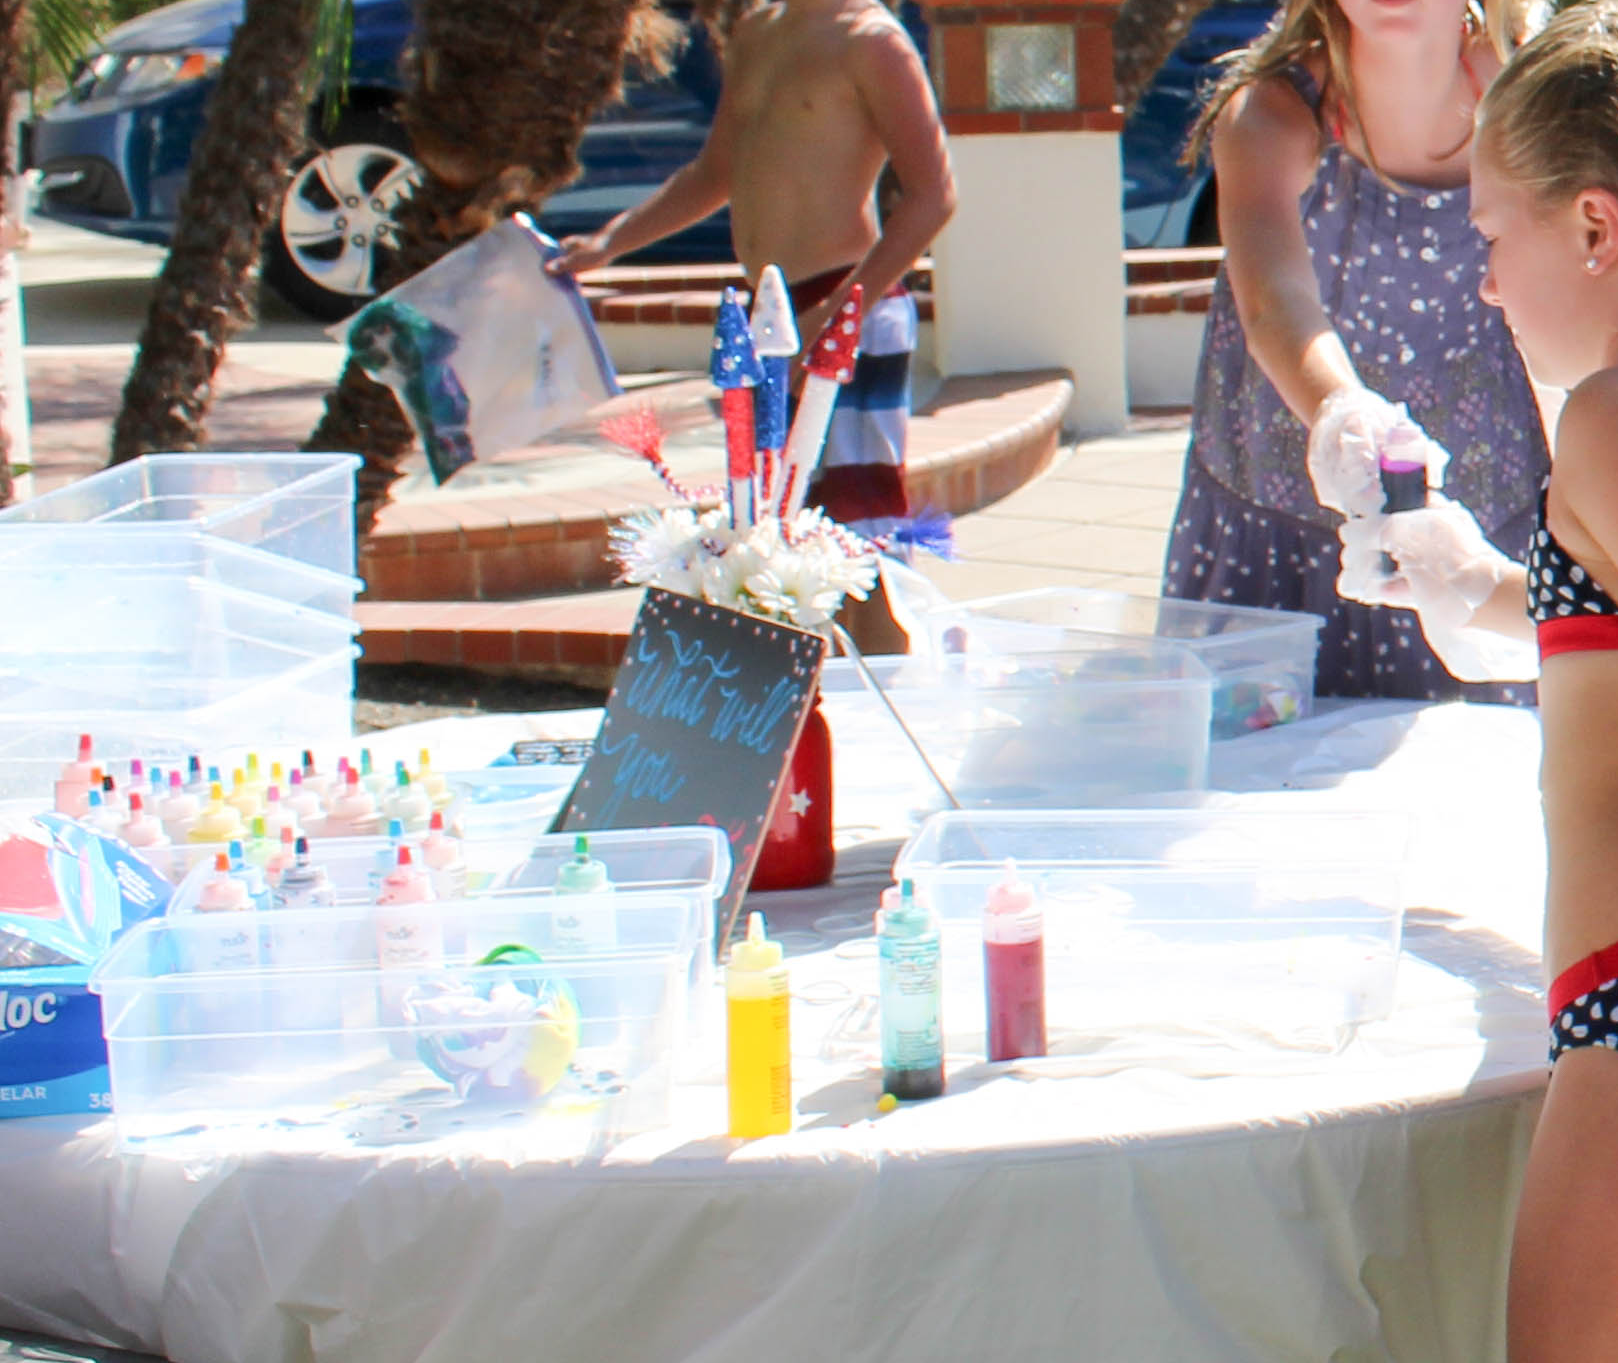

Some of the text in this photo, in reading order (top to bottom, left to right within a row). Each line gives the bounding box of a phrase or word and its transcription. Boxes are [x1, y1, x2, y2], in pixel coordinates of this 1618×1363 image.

[627, 630, 799, 754] What will
[592, 733, 687, 829] you
